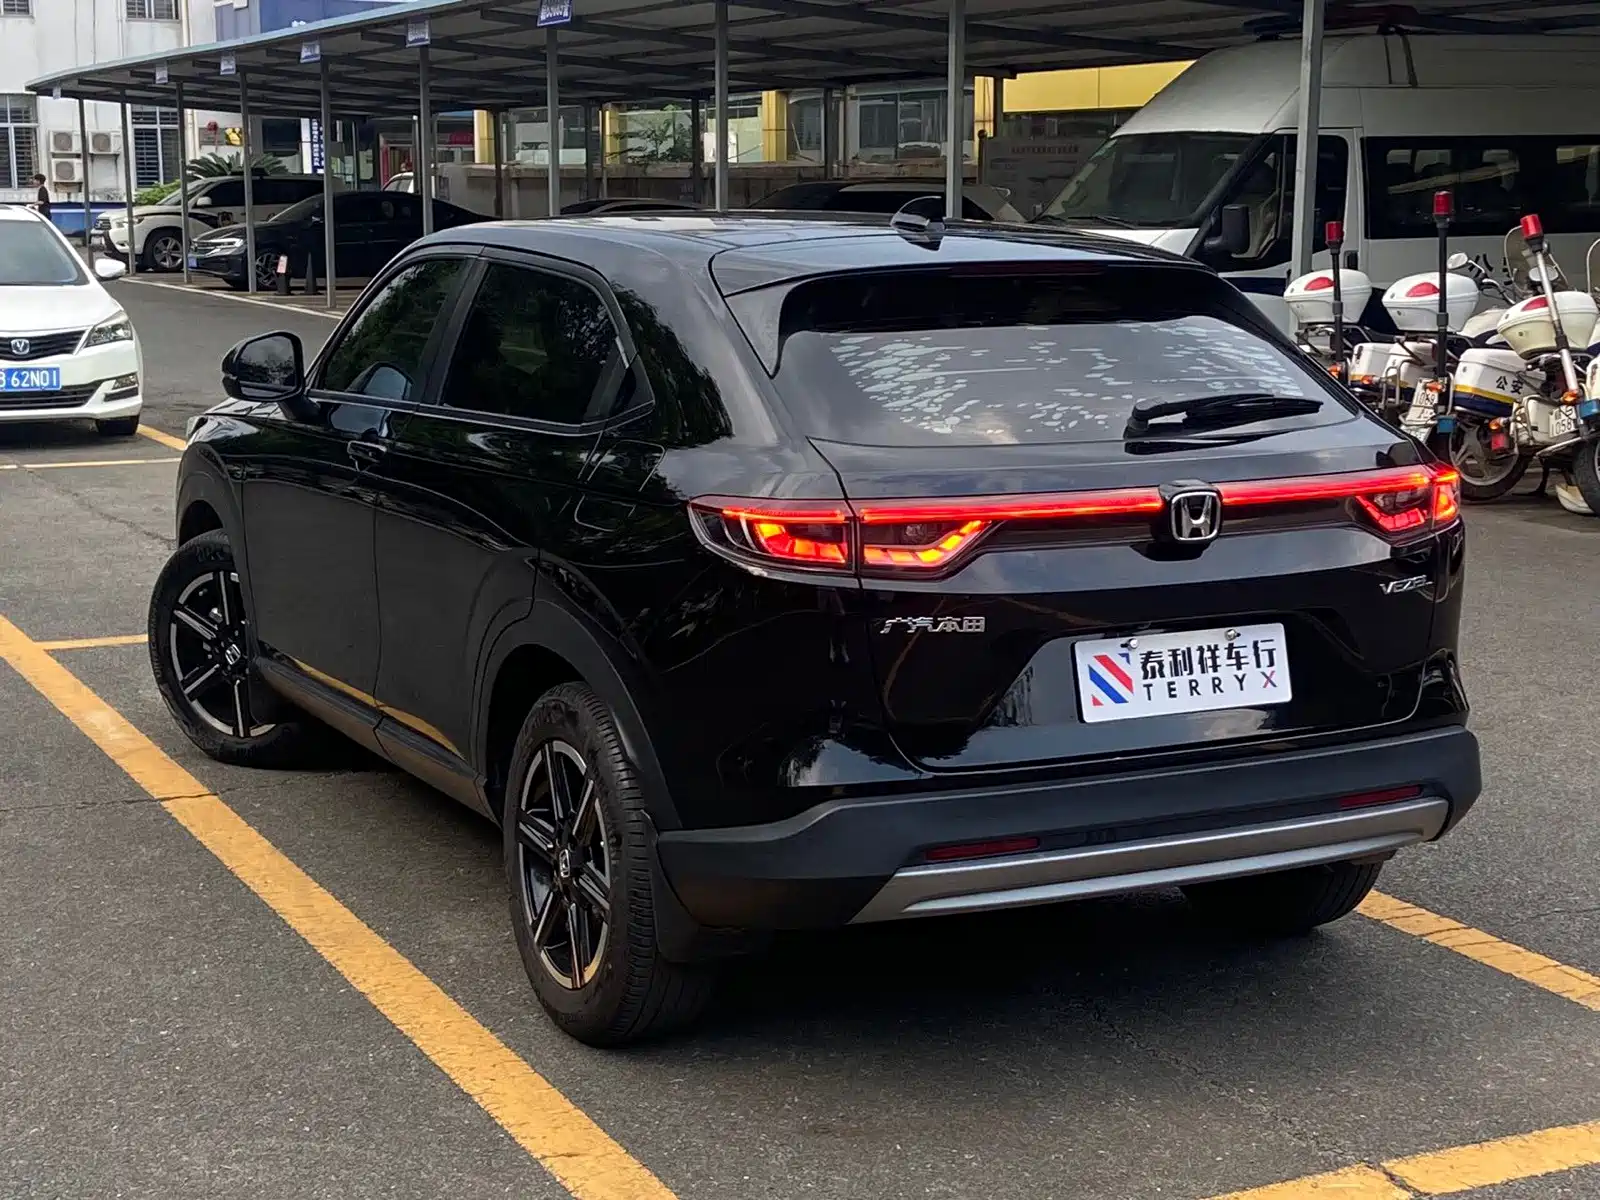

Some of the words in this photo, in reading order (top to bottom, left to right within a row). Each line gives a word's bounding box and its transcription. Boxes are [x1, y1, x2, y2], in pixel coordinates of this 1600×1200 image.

[1496, 375, 1524, 394] 公安
[880, 616, 986, 634] 广汽本田
[1139, 638, 1277, 680] 泰利祥车行
